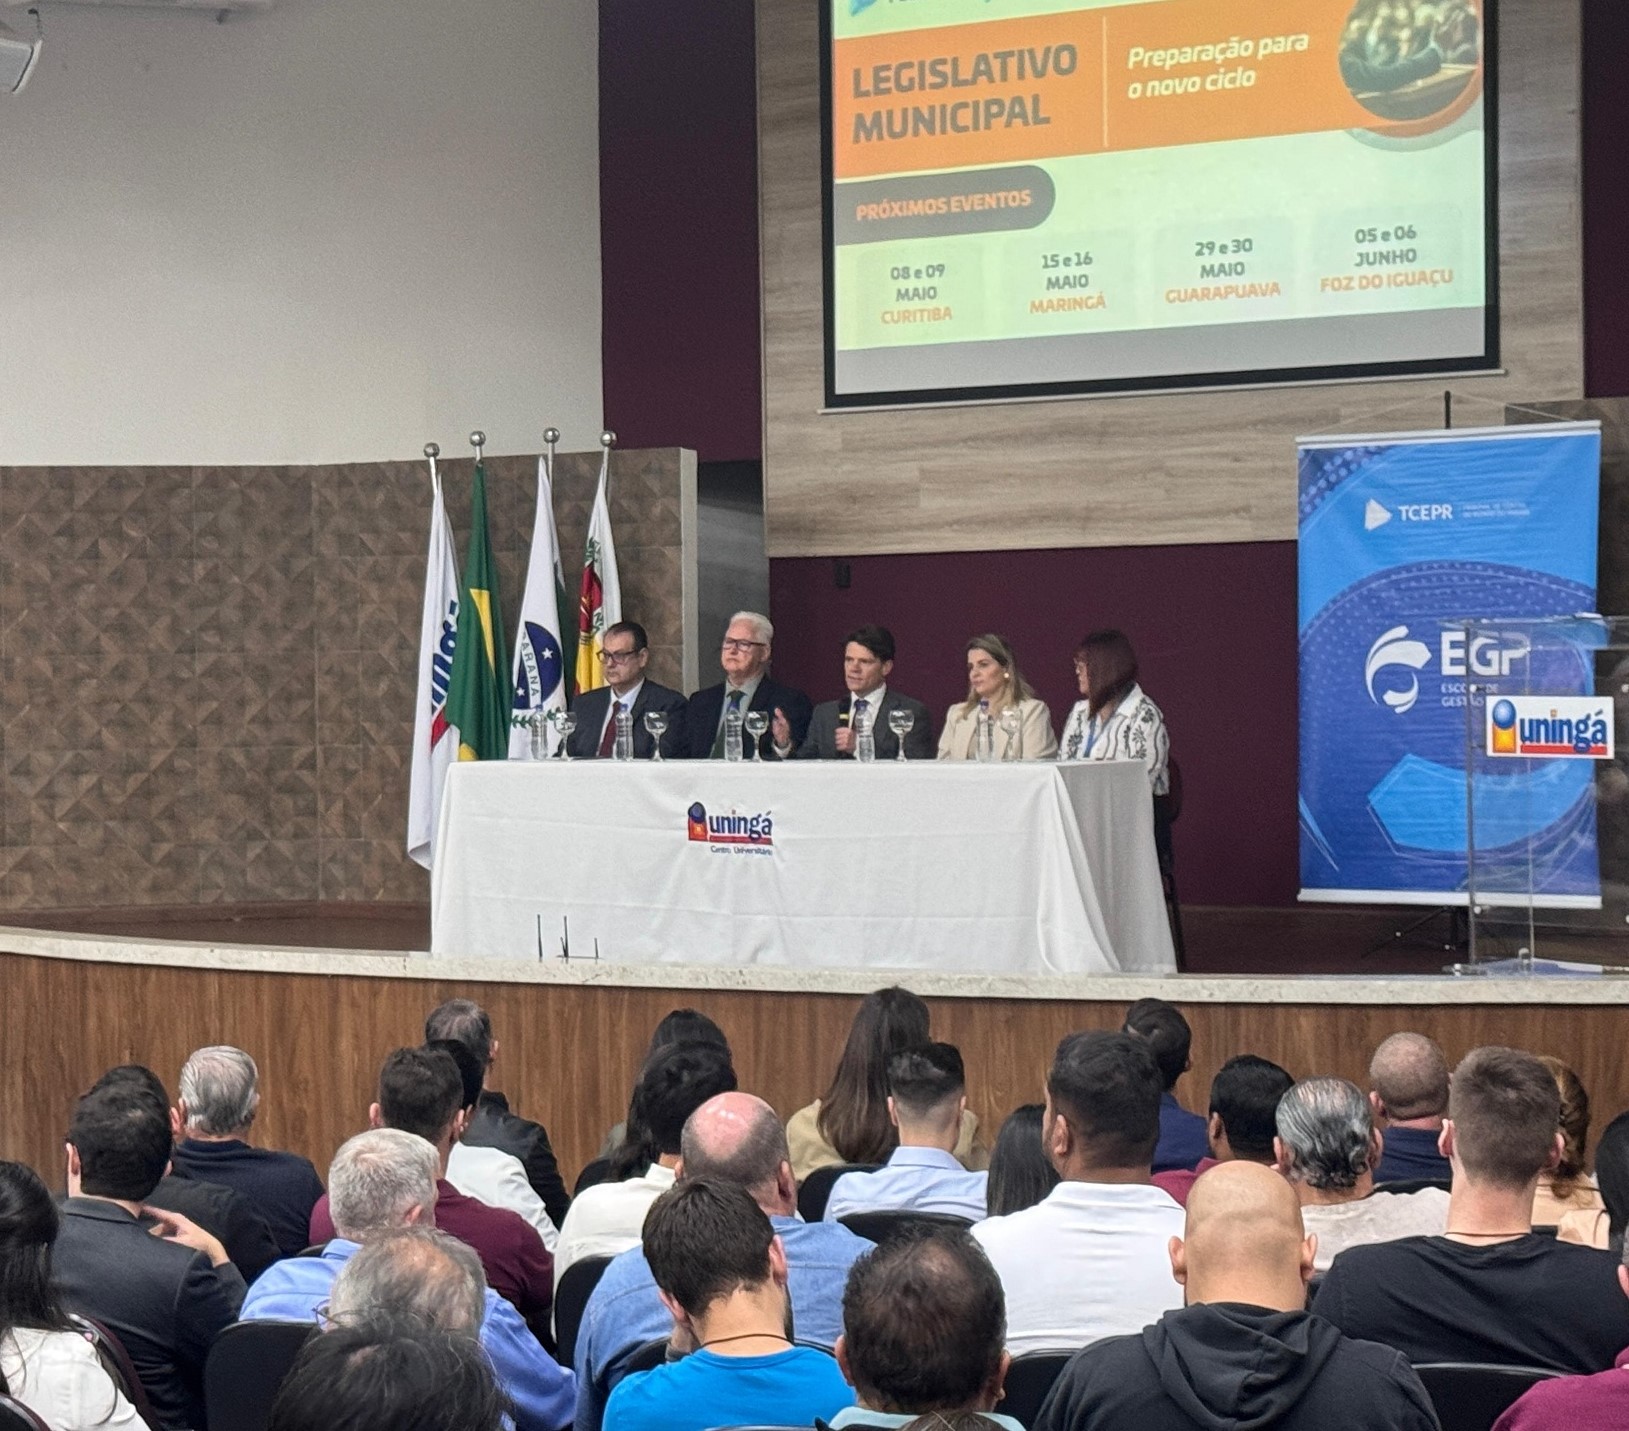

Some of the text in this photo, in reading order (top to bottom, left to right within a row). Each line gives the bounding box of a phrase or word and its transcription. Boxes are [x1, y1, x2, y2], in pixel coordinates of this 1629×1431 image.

[1128, 33, 1309, 70] Preparação para
[853, 44, 1077, 98] LEGISLATIVO
[1128, 66, 1256, 99] o novo ciclo
[853, 94, 1051, 144] MUNICIPAL
[856, 190, 1032, 221] PRÓXIMOS EVENTOS
[1355, 225, 1417, 243] 05 e 06
[1195, 238, 1253, 256] 29 e 30
[1354, 248, 1417, 267] JUNHO
[1042, 252, 1093, 269] 15 e 16
[1200, 261, 1245, 279] MAIO
[891, 264, 945, 280] 08 e 09
[1046, 274, 1089, 291] MAIO
[1320, 269, 1454, 292] FOZ DO IGUAÇU
[896, 286, 937, 302] MAIO
[1030, 291, 1107, 313] MARINGÁ
[1165, 282, 1281, 304] GUARAPUAVA
[881, 306, 953, 324] CURITIBA
[1398, 504, 1453, 521] TCEPR
[1441, 631, 1531, 676] EGP
[1520, 709, 1607, 753] uningá
[709, 809, 773, 842] uningá
